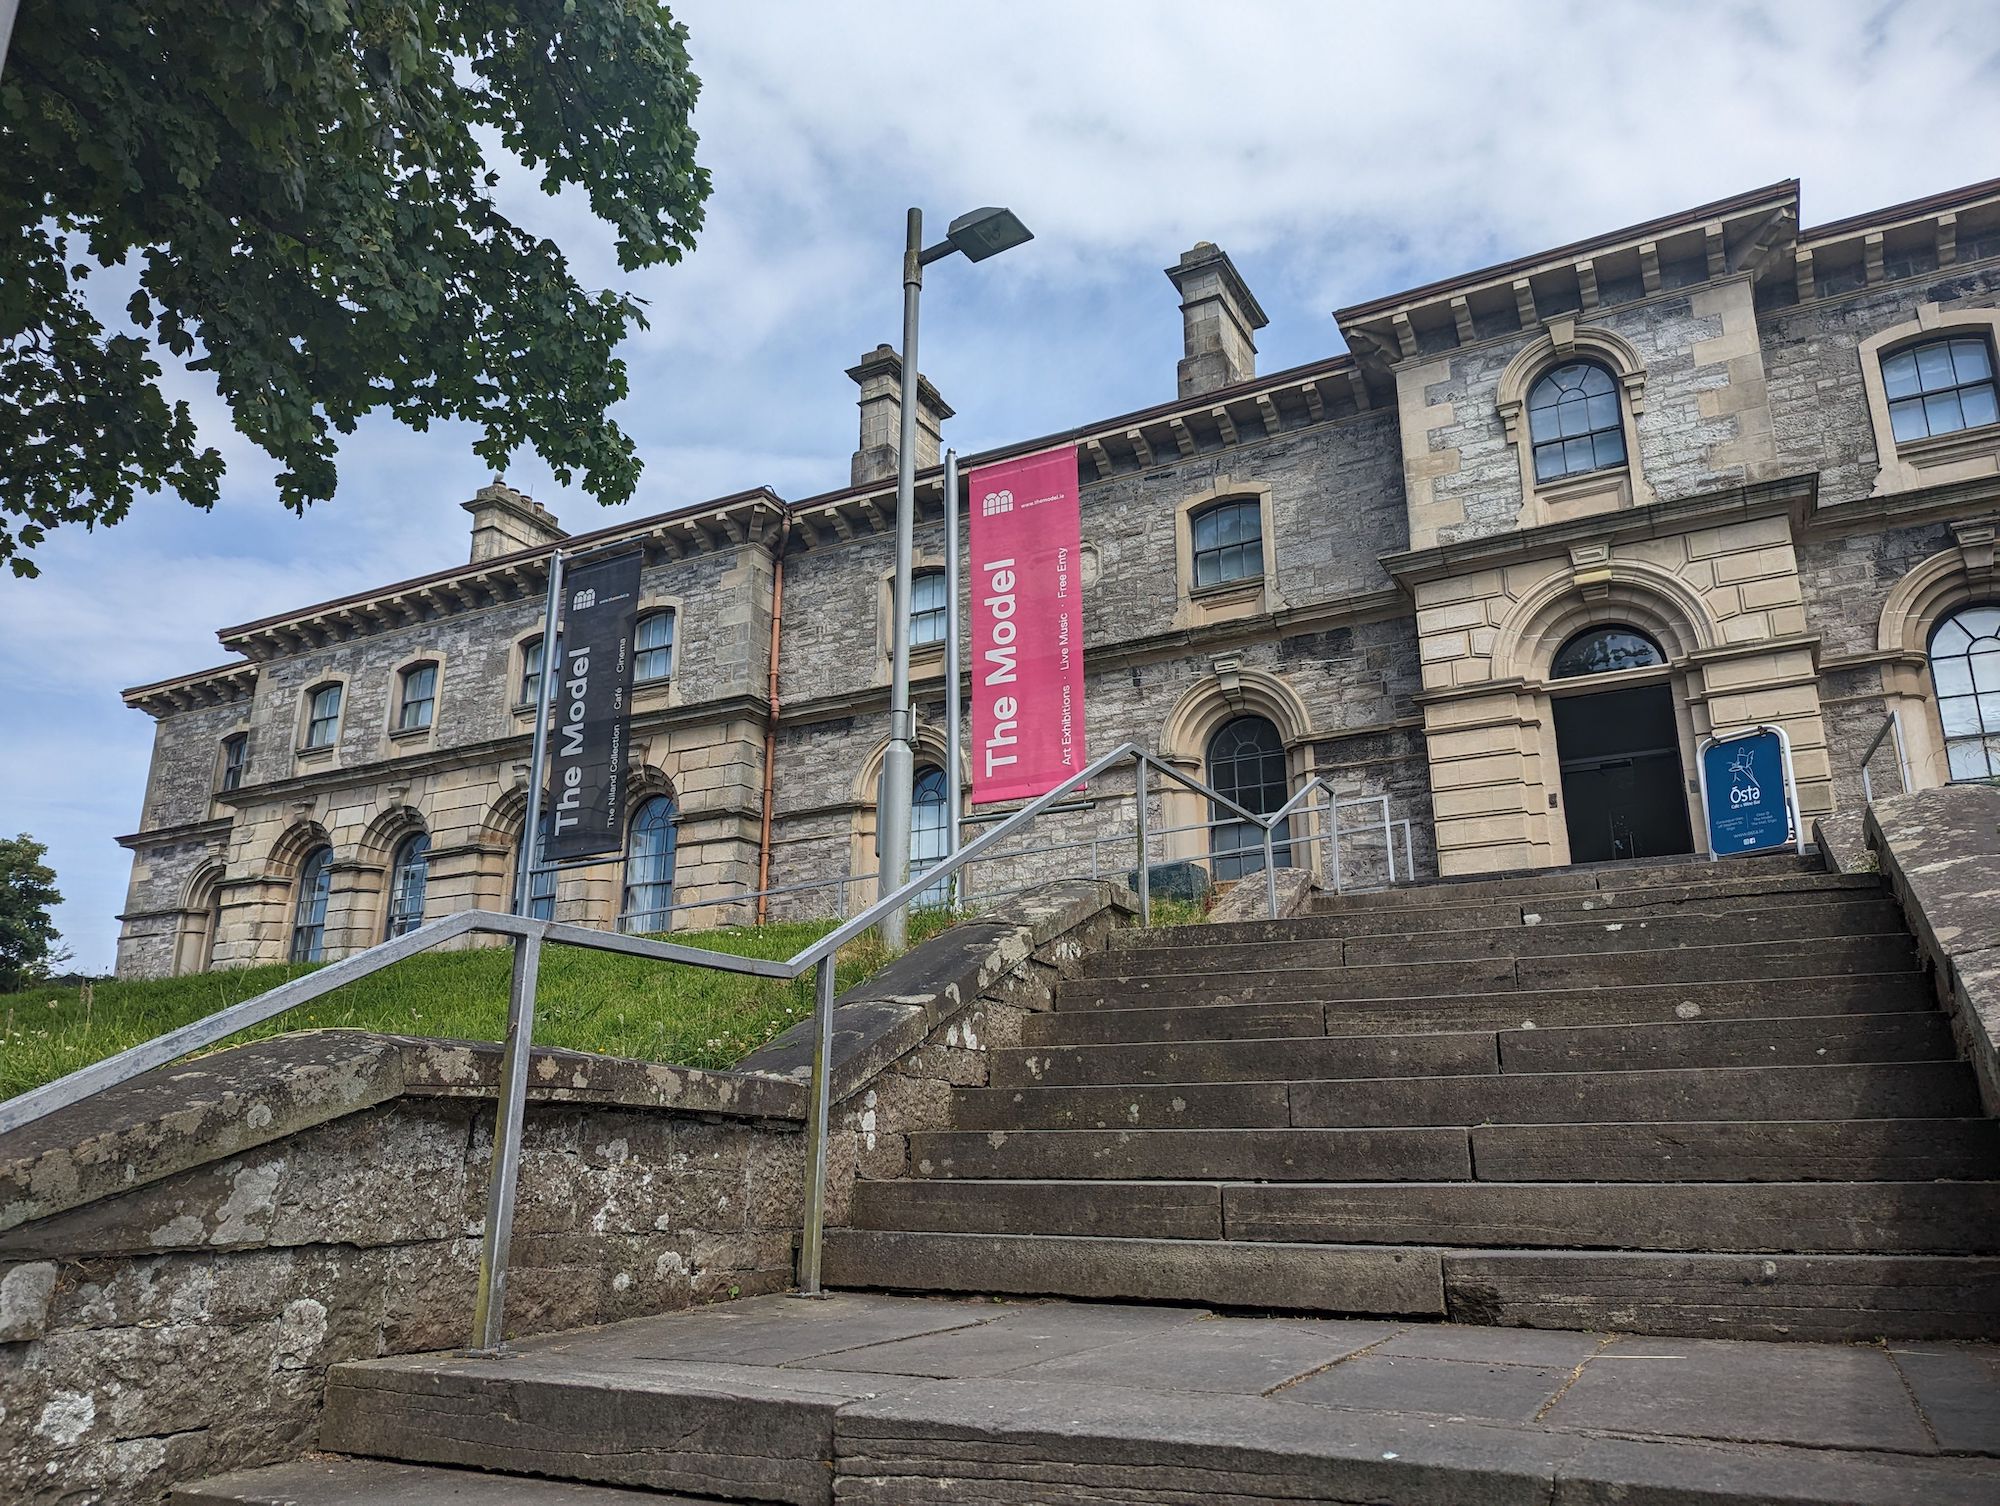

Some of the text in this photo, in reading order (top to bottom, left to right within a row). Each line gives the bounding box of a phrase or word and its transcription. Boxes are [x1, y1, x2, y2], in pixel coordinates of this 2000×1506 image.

[1020, 494, 1065, 508] www.themodel.ie
[554, 646, 591, 836] The Model
[607, 638, 626, 828] The Niland Collection Café Cinema
[983, 558, 1018, 778] The Model
[1057, 547, 1071, 765] Art Exhibitions Live Music Free Enty
